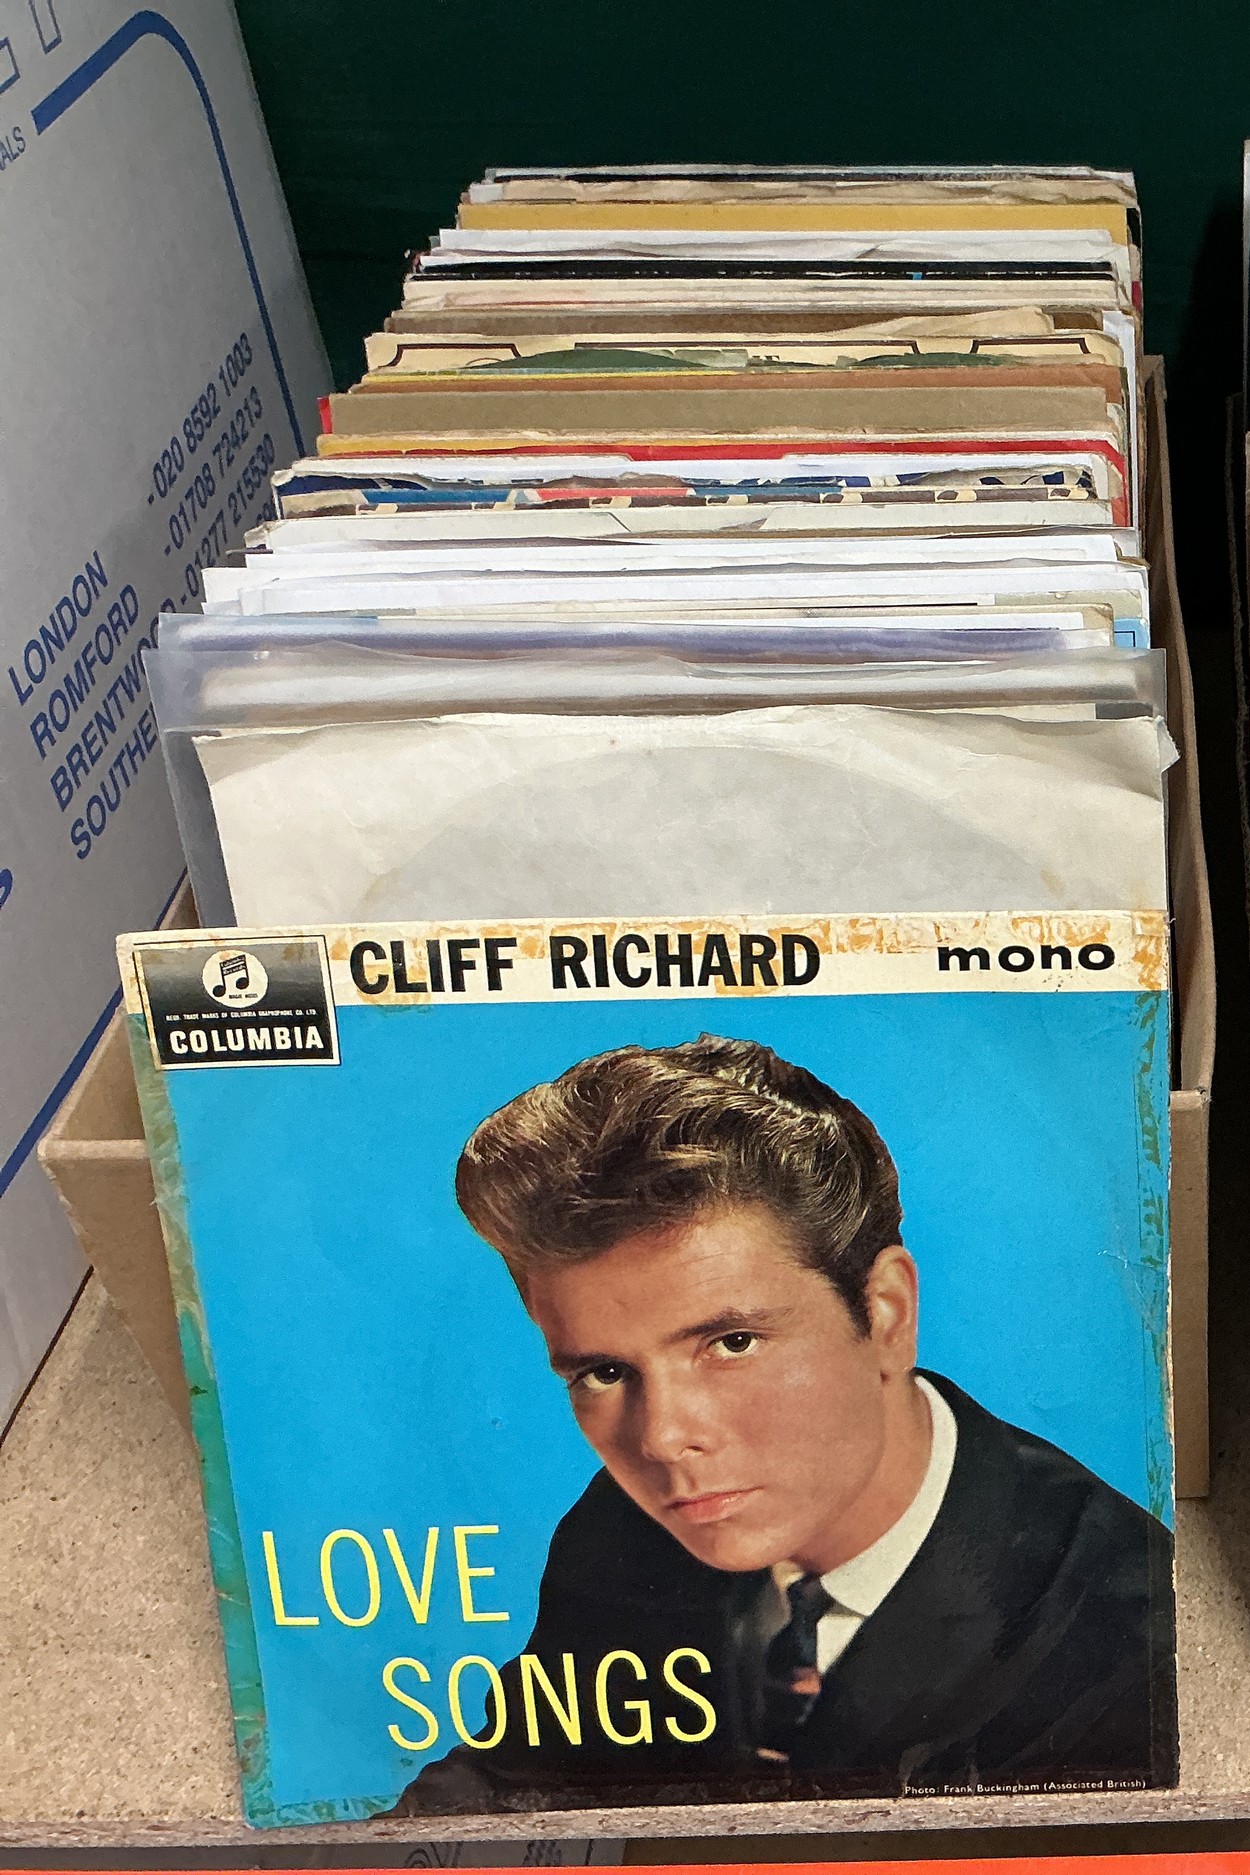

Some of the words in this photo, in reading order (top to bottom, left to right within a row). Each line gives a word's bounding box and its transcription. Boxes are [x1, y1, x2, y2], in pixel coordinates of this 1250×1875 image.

[8, 551, 108, 705] LONDON
[183, 383, 221, 454] 8592
[219, 333, 253, 397] 1003
[30, 585, 138, 760] ROMFORD
[212, 386, 262, 478] 724213
[51, 599, 175, 812] BRENTW
[350, 937, 516, 995] CLIFF
[551, 933, 820, 989] RICHARD
[937, 943, 1115, 973] mono
[169, 1025, 324, 1054] COLUMBIA
[262, 1524, 510, 1628] LOVE
[382, 1648, 717, 1751] SONGS
[944, 1784, 973, 1793] Frank
[977, 1783, 1040, 1794] Buckingham
[1043, 1781, 1103, 1791] (Associated
[1107, 1779, 1147, 1789] British)
